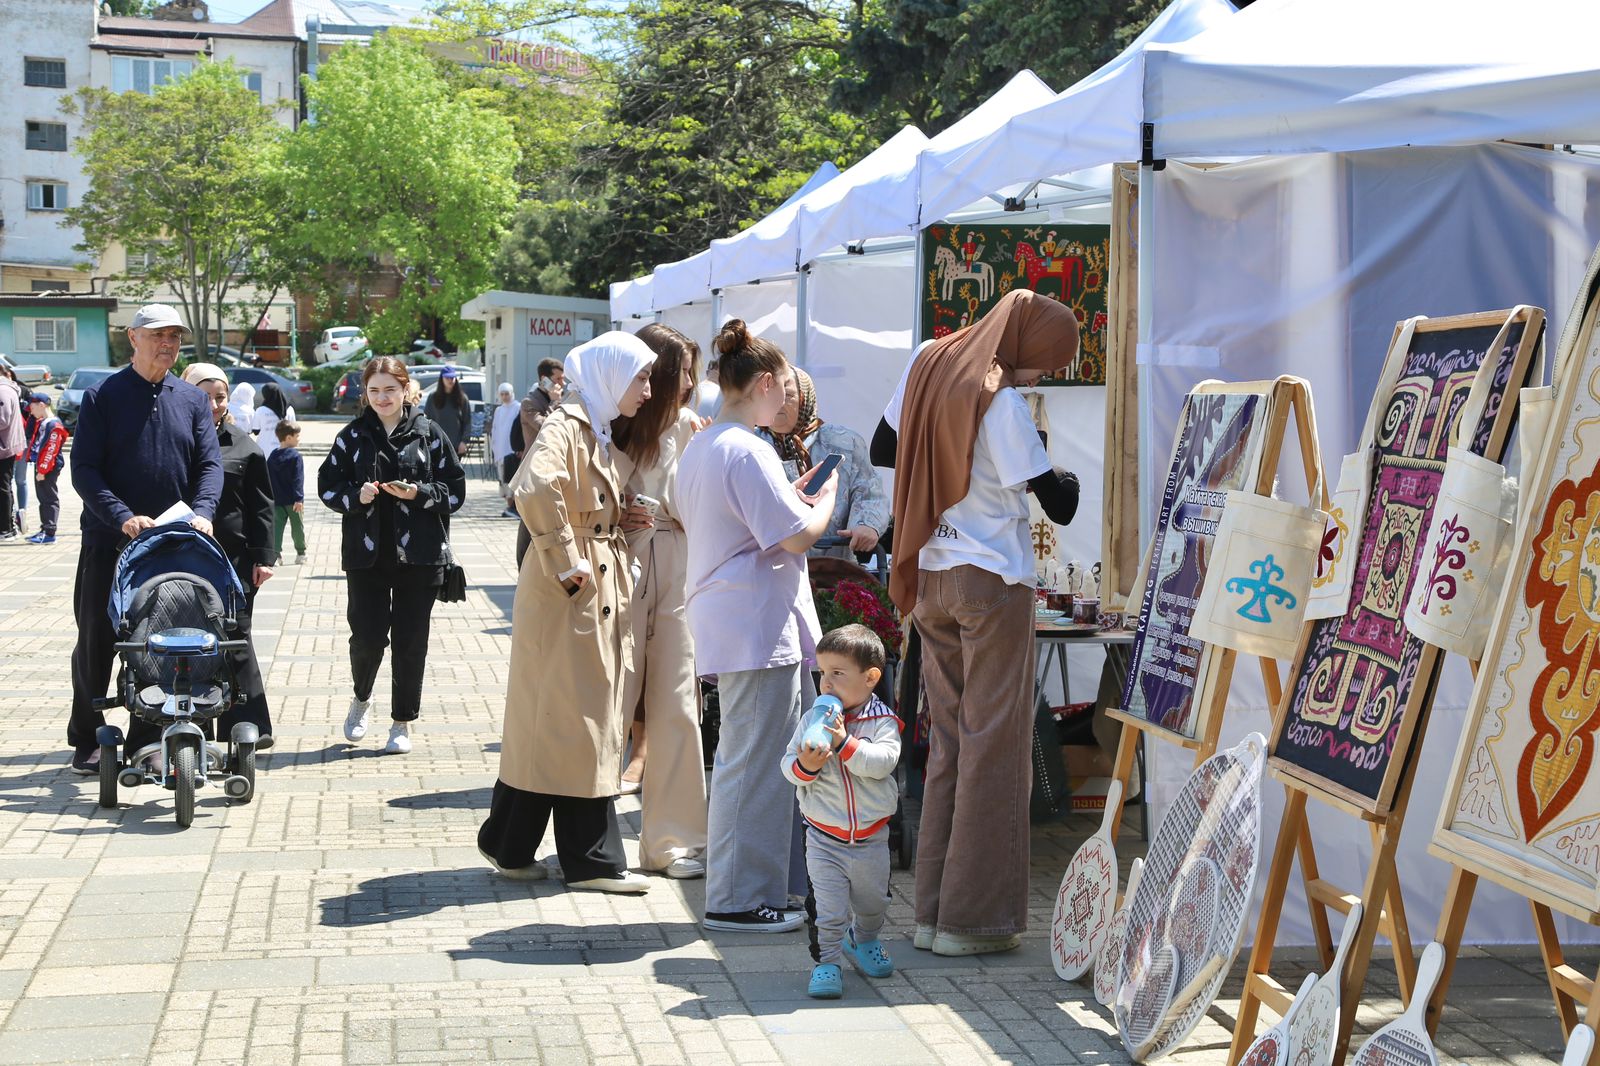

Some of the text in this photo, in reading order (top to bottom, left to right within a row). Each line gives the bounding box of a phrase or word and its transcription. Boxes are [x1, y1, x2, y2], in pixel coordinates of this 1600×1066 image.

[530, 318, 571, 336] КАССА
[1137, 580, 1154, 633] KAITAG
[1151, 531, 1165, 570] TEXTILE
[1160, 507, 1170, 525] ART
[1165, 471, 1177, 500] FROM
[1131, 639, 1141, 674] Publication
